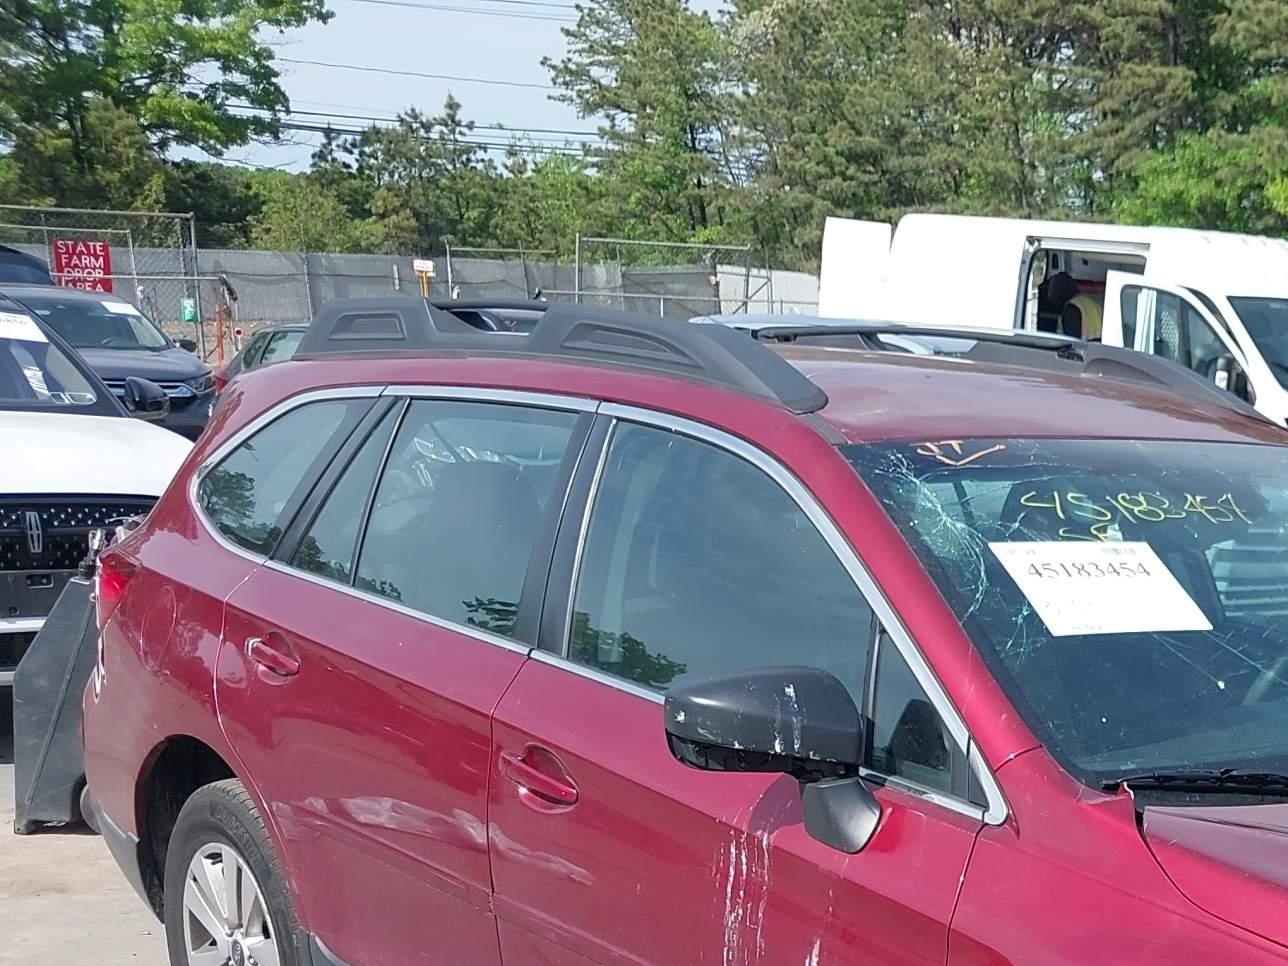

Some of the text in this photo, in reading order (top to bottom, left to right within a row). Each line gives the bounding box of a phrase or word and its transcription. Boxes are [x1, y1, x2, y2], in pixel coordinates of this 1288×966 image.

[57, 240, 105, 255] STATE
[61, 254, 104, 269] FARM
[63, 267, 104, 281] DROP
[1028, 562, 1151, 578] 45183454
